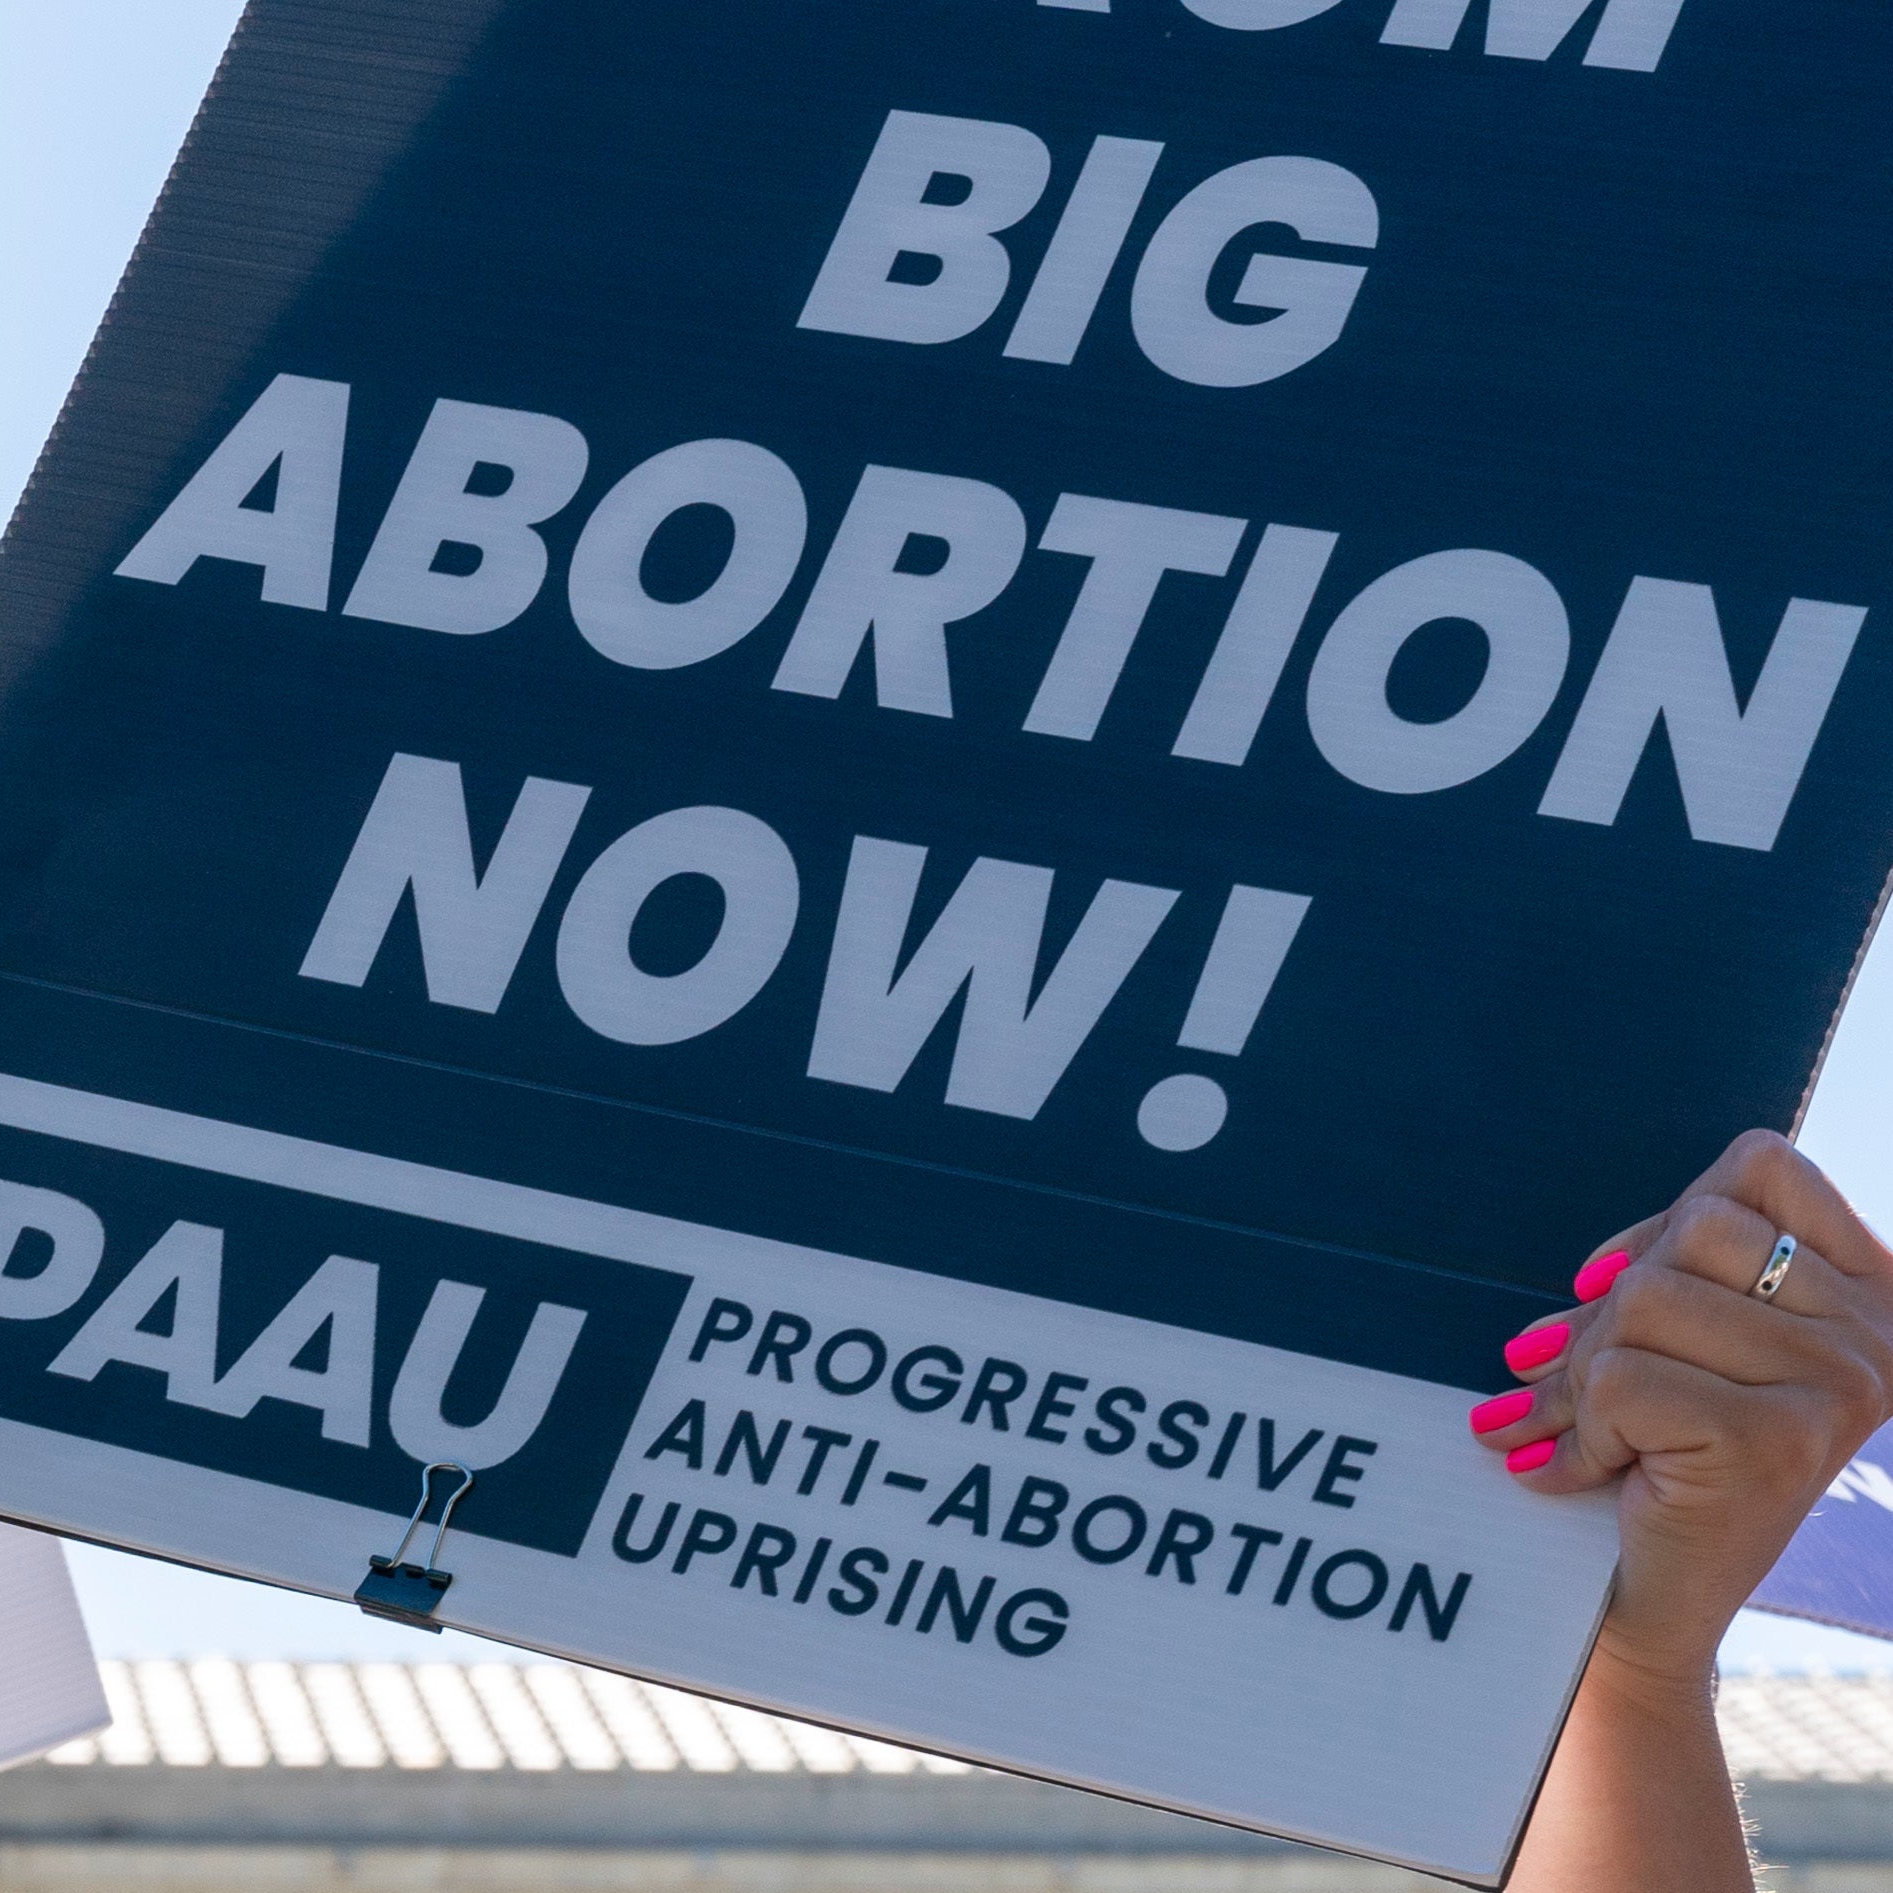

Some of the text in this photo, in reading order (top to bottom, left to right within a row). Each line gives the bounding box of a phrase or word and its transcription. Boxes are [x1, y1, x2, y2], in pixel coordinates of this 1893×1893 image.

[796, 109, 1379, 388] BIG
[112, 375, 1869, 853] ABORTION
[298, 753, 1313, 1152] NOW!
[646, 1401, 1471, 1643] ANTI-ABORTION
[689, 1301, 1378, 1509] PROGRESSIVE
[611, 1496, 1068, 1658] UPRISING
